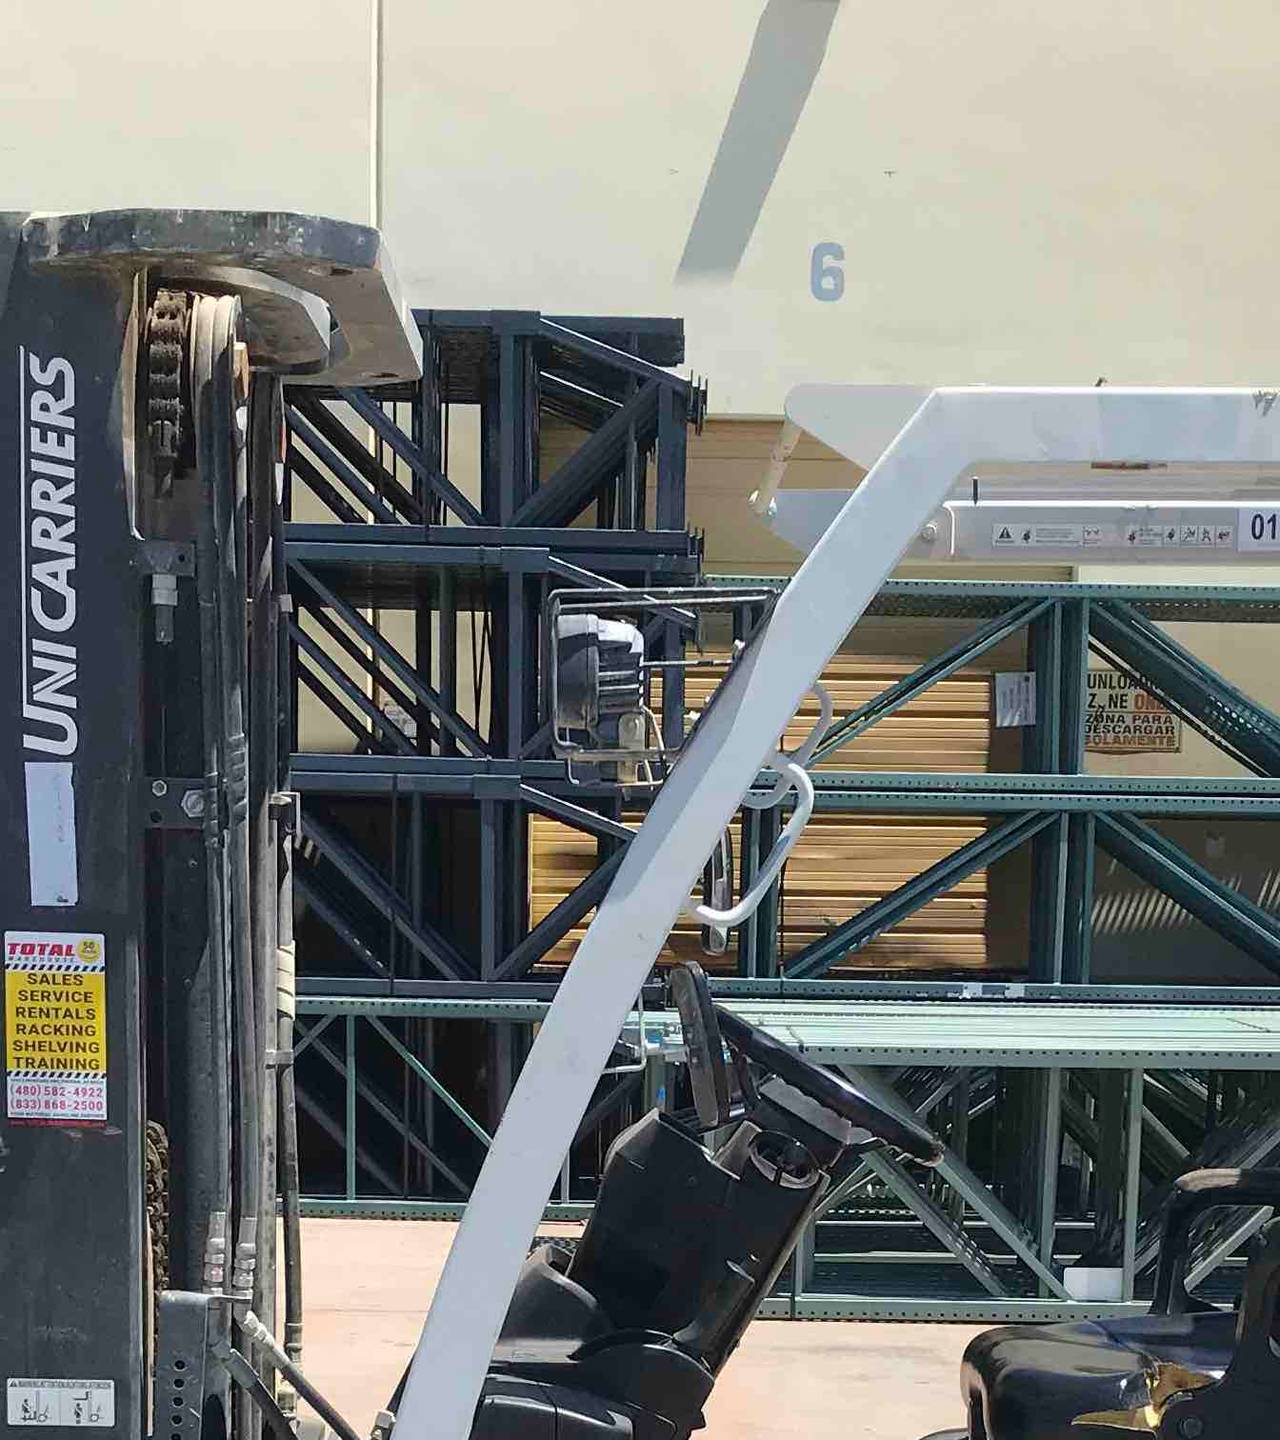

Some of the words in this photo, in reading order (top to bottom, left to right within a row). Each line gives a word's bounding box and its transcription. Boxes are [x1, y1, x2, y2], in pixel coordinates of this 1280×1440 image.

[811, 242, 845, 301] 6
[1132, 714, 1173, 725] PARA
[7, 943, 76, 956] TOTAL
[27, 973, 84, 986] SALES
[18, 990, 94, 1004] SERVICE
[16, 1007, 96, 1021] RENTALS
[16, 1023, 96, 1037] RACKING
[12, 1040, 100, 1053] SHELVING
[13, 1056, 100, 1070] TRAINING
[10, 1084, 41, 1096] (480)
[44, 1086, 103, 1098] 582-4922
